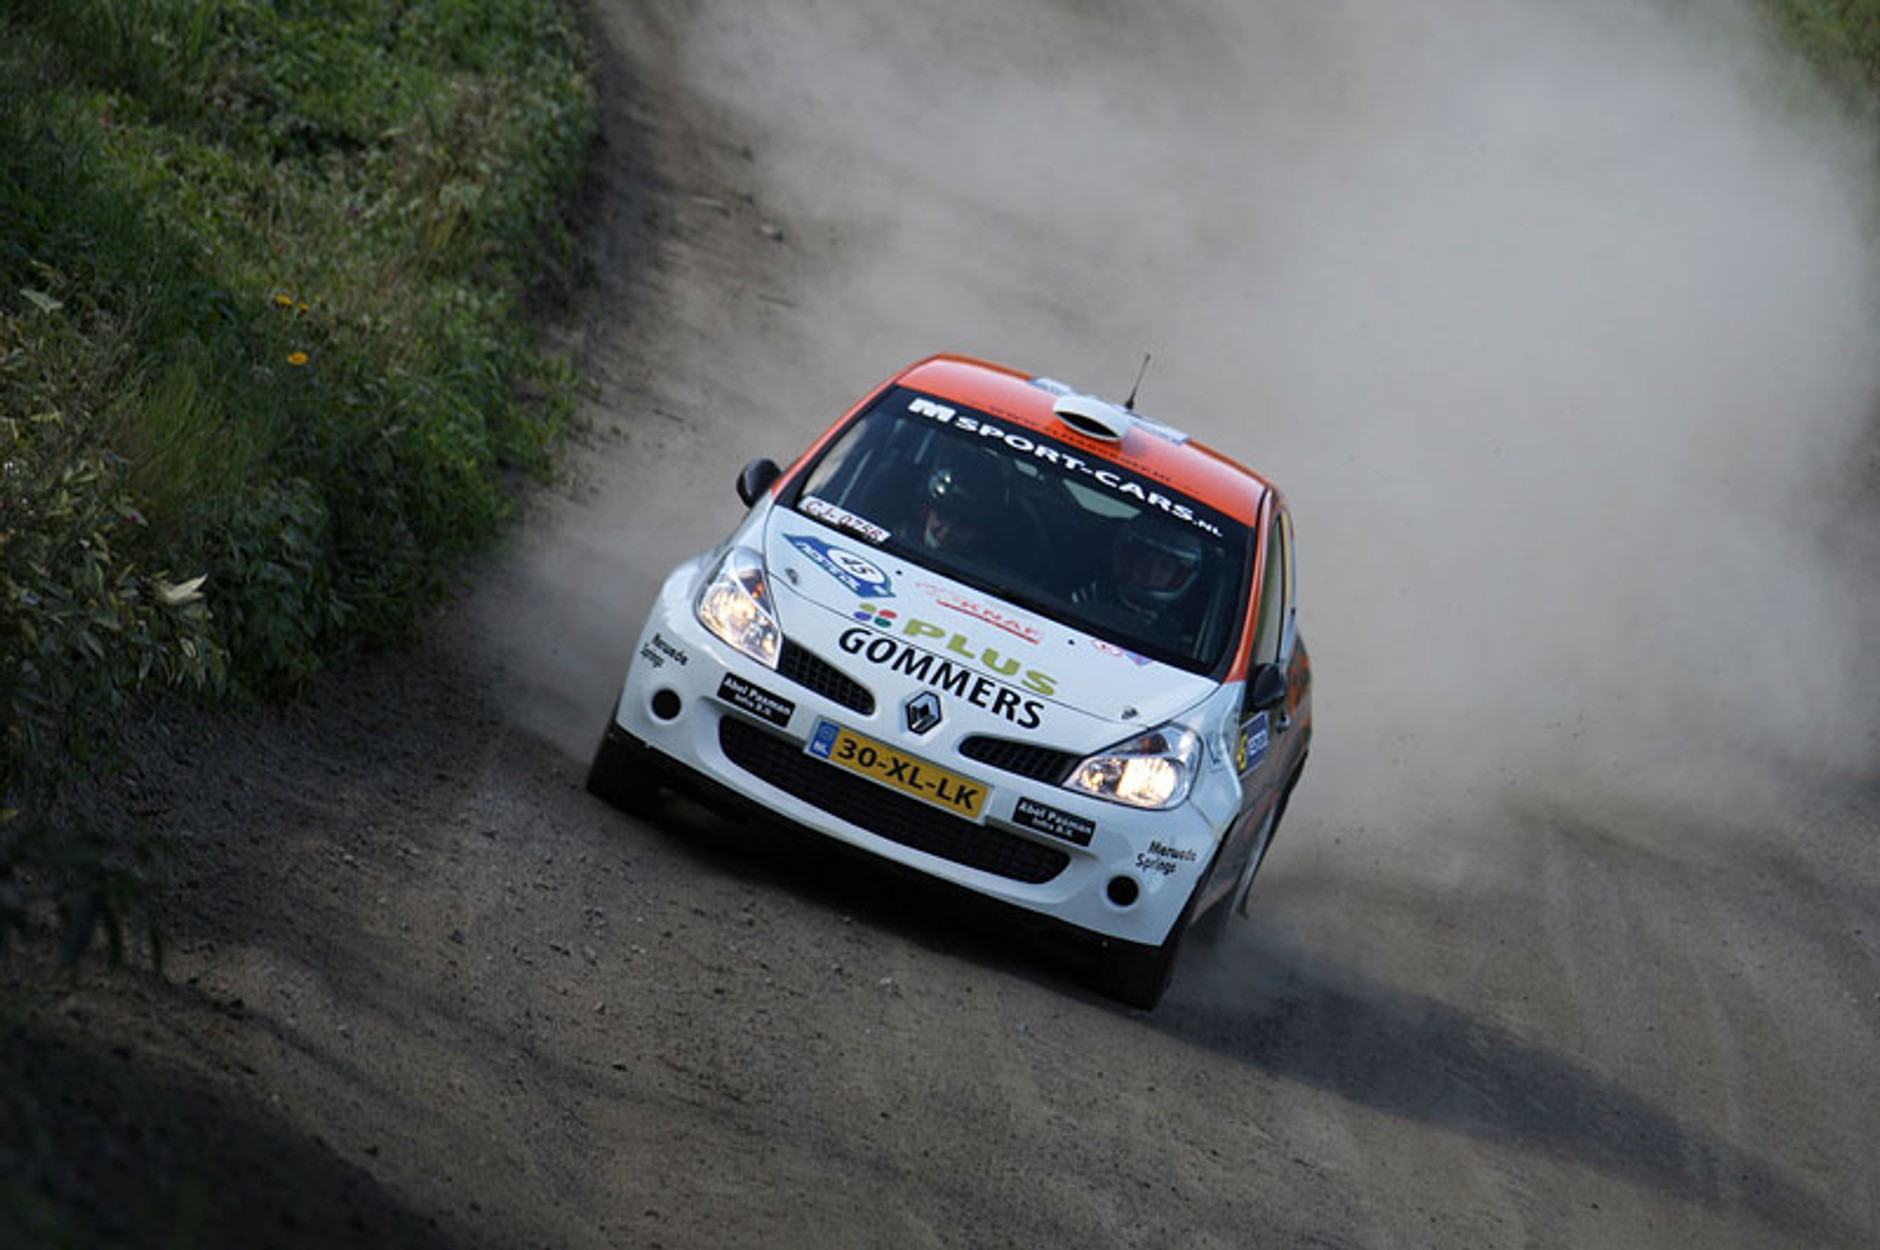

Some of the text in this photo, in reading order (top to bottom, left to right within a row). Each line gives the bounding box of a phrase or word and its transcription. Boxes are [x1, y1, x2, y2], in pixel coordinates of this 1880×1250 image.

[838, 627, 1045, 730] GOMMERS
[903, 618, 1058, 696] PLUS
[836, 738, 978, 810] 30-XL-LK
